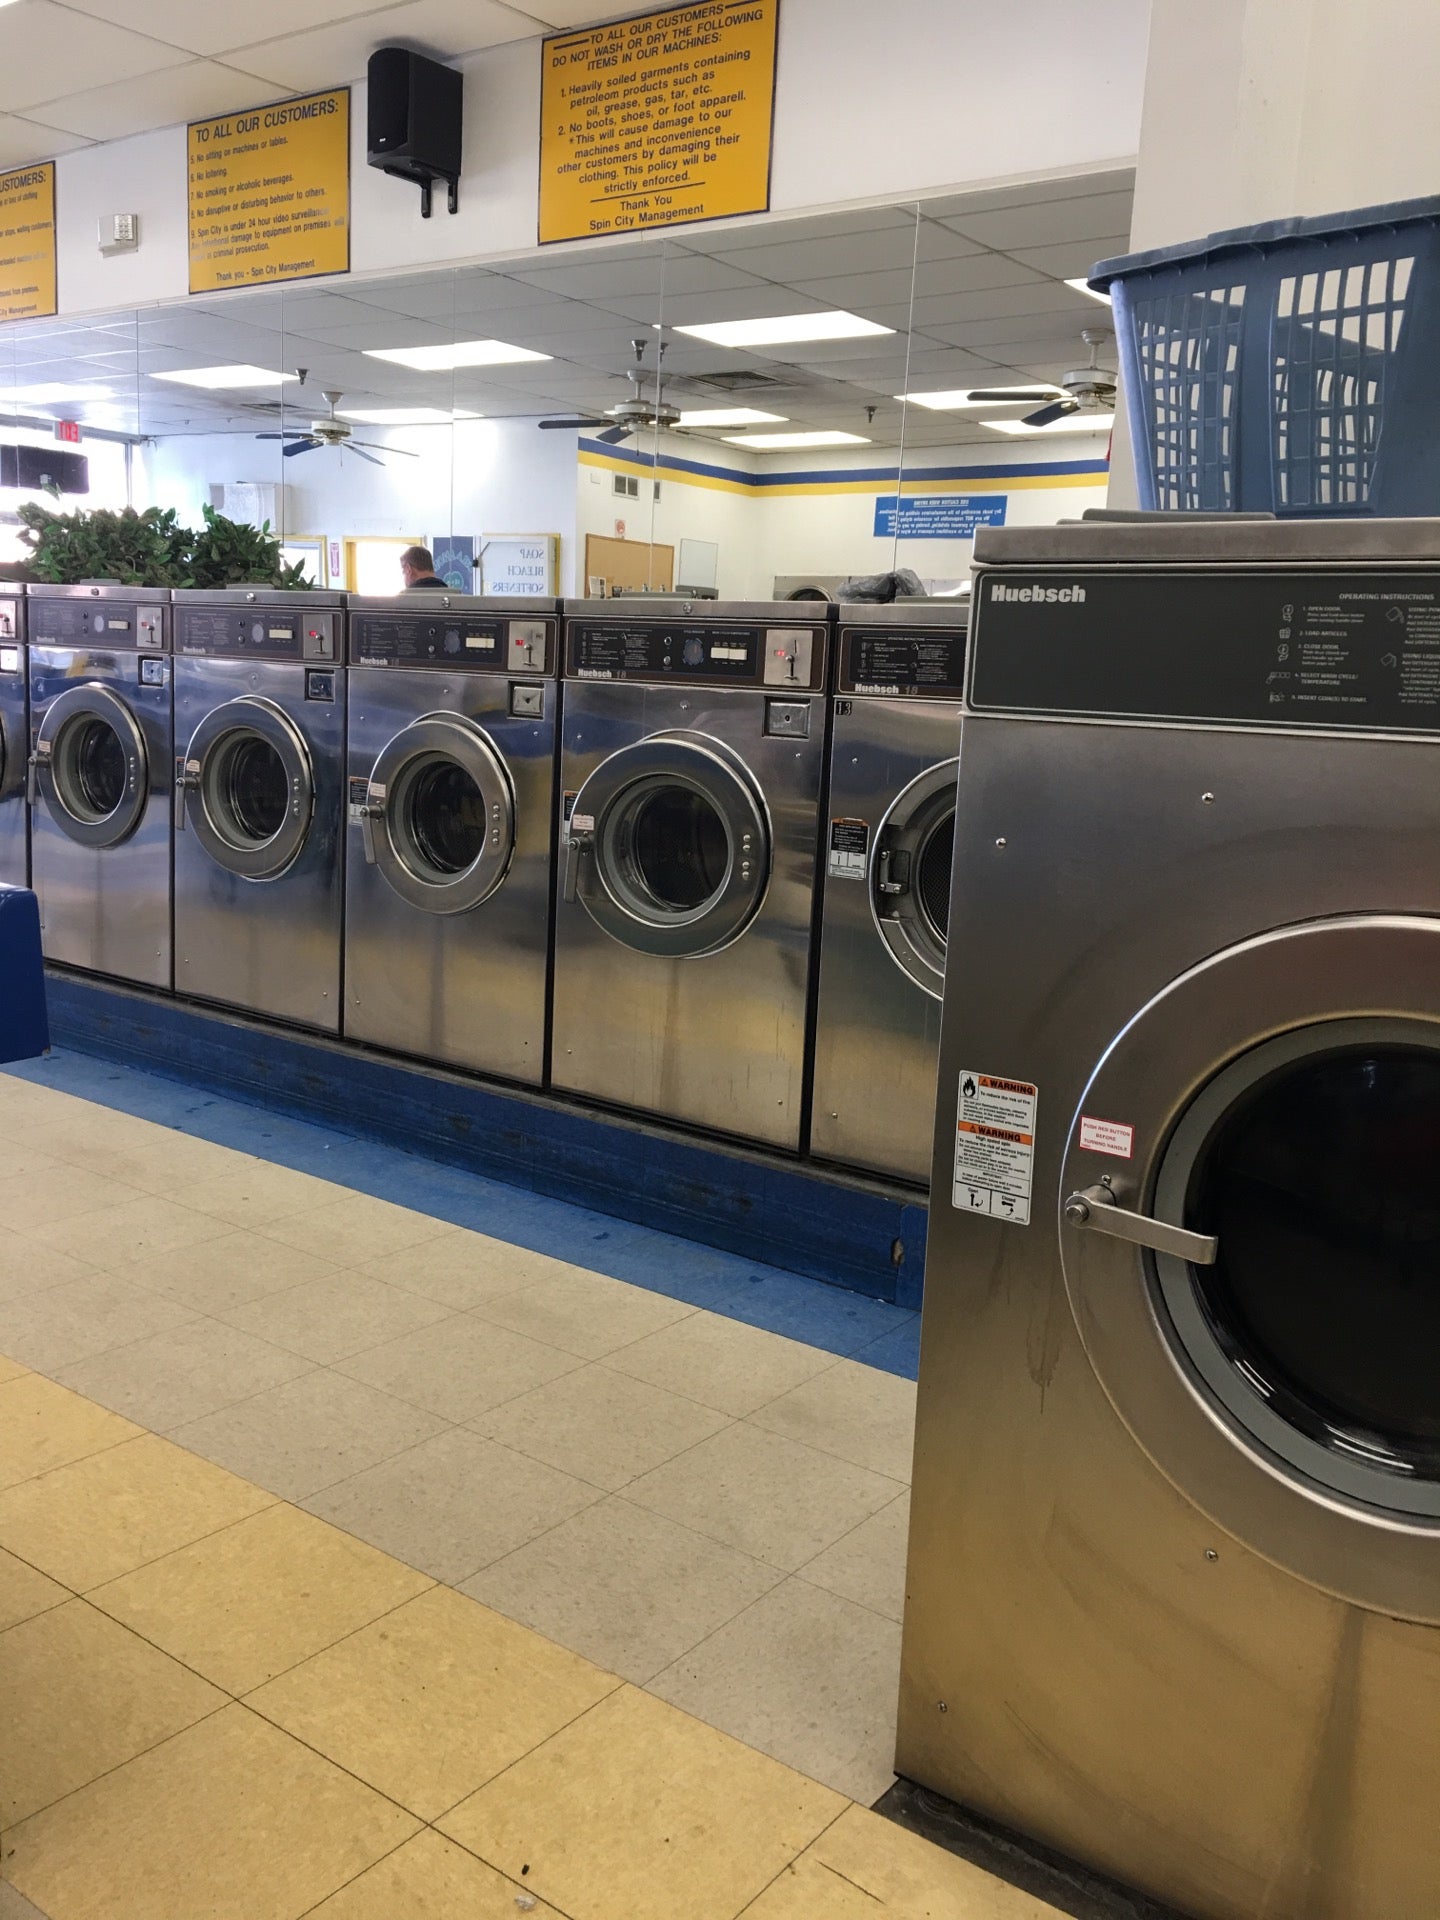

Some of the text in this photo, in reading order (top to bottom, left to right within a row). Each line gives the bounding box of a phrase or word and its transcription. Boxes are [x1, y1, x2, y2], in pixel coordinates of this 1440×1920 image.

[590, 4, 724, 45] TO ALL OUR CUSTOMERS
[552, 9, 763, 68] DO NOT WASH OR DRY THE FOLLOWING
[587, 32, 722, 71] ITEMS IN OUR MACHINES:
[561, 49, 751, 98] 1. Heavily soiled garments containing
[623, 80, 668, 99] products
[673, 71, 697, 86] such
[702, 70, 715, 80] as
[558, 90, 746, 136] 2. No boots, shoes, or foot apparell.
[586, 85, 712, 117] oil, grease, gas, tar, etc.
[196, 99, 338, 143] TO ALL OUR CUSTOMERS:
[599, 129, 614, 141] will
[618, 124, 648, 137] cause
[653, 115, 694, 136] damage
[699, 112, 710, 122] to
[715, 108, 733, 119] our
[197, 154, 204, 162] No
[206, 150, 222, 160] sitting
[233, 143, 258, 154] machines
[270, 136, 288, 146] tables.
[557, 133, 740, 174] other customers by damaging their
[574, 125, 721, 159] machines and inconvenience
[579, 152, 717, 184] clothing. This policy will be
[205, 187, 227, 197] smoking
[236, 178, 261, 190] alcoholic
[263, 174, 294, 186] beverages.
[604, 172, 690, 194] strictly enforced.
[206, 204, 230, 216] disruptive
[241, 198, 268, 209] disturbing
[270, 193, 294, 204] behavior
[620, 195, 672, 212] Thank You
[198, 227, 209, 237] Spin
[210, 225, 221, 235] City
[230, 221, 246, 231] under
[258, 218, 270, 226] hour
[273, 215, 289, 224] video
[590, 204, 704, 232] Spin City Management
[231, 234, 252, 243] damage
[263, 226, 291, 237] equipment
[216, 259, 315, 282] Thank you Spin City Management
[992, 584, 1086, 603] Huebsch
[578, 669, 612, 678] Huebsch
[855, 684, 899, 694] Huebsch
[837, 702, 852, 715] 13
[990, 1080, 1032, 1094] WARNING
[978, 1127, 1020, 1141] WARNING
